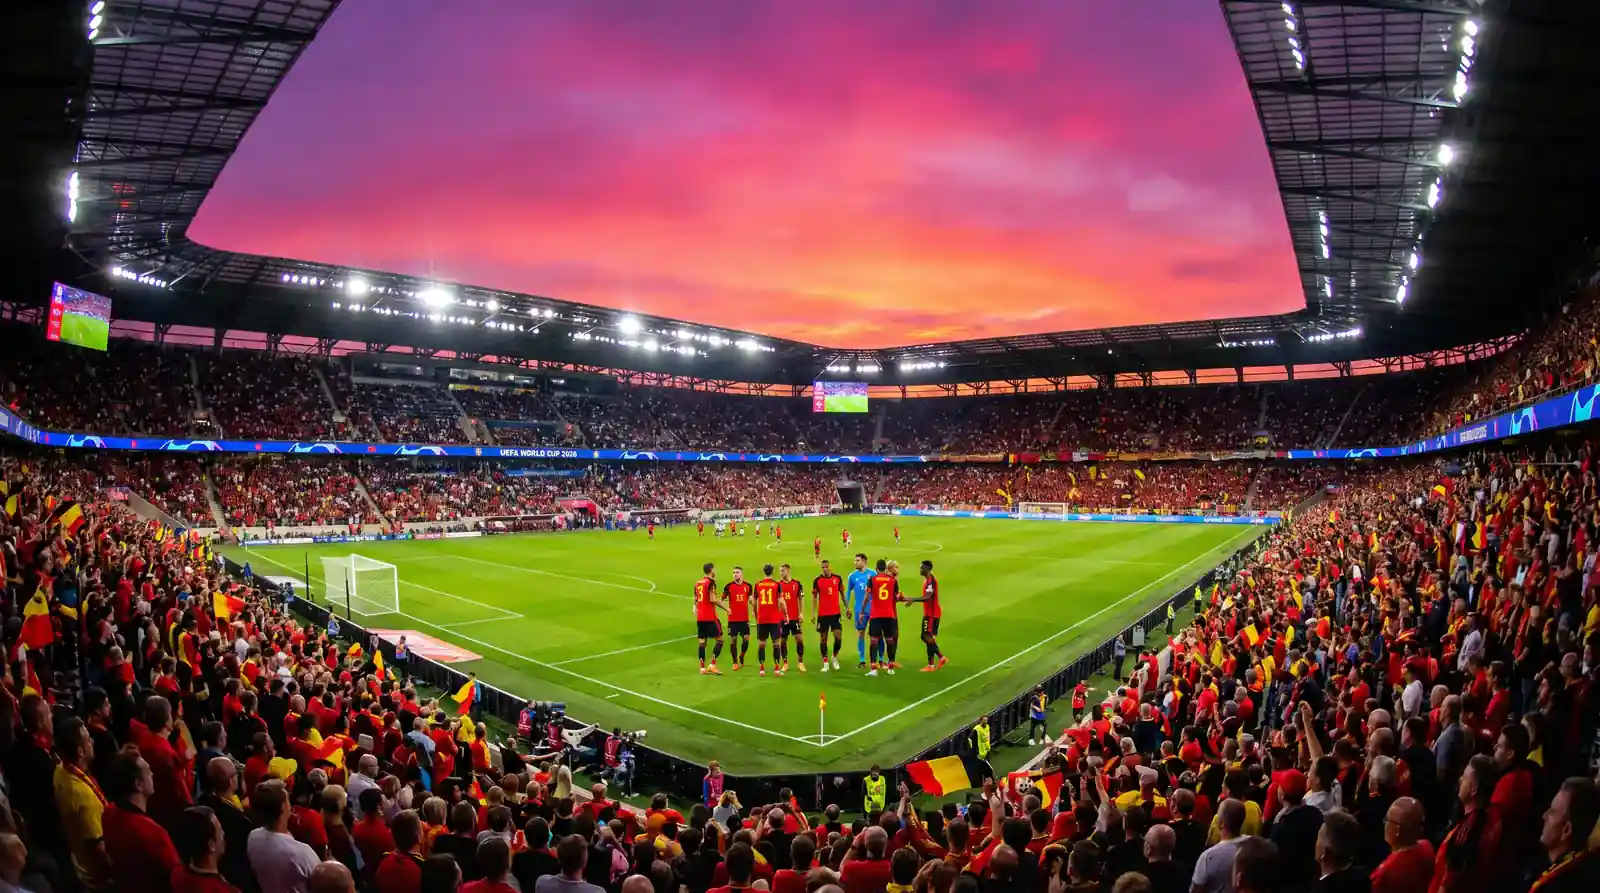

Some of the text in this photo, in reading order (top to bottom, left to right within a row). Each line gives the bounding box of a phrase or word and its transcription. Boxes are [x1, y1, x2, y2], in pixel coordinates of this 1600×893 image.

[520, 449, 545, 457] WORLD
[697, 585, 704, 602] 3
[760, 588, 774, 605] 11
[878, 583, 889, 601] 6
